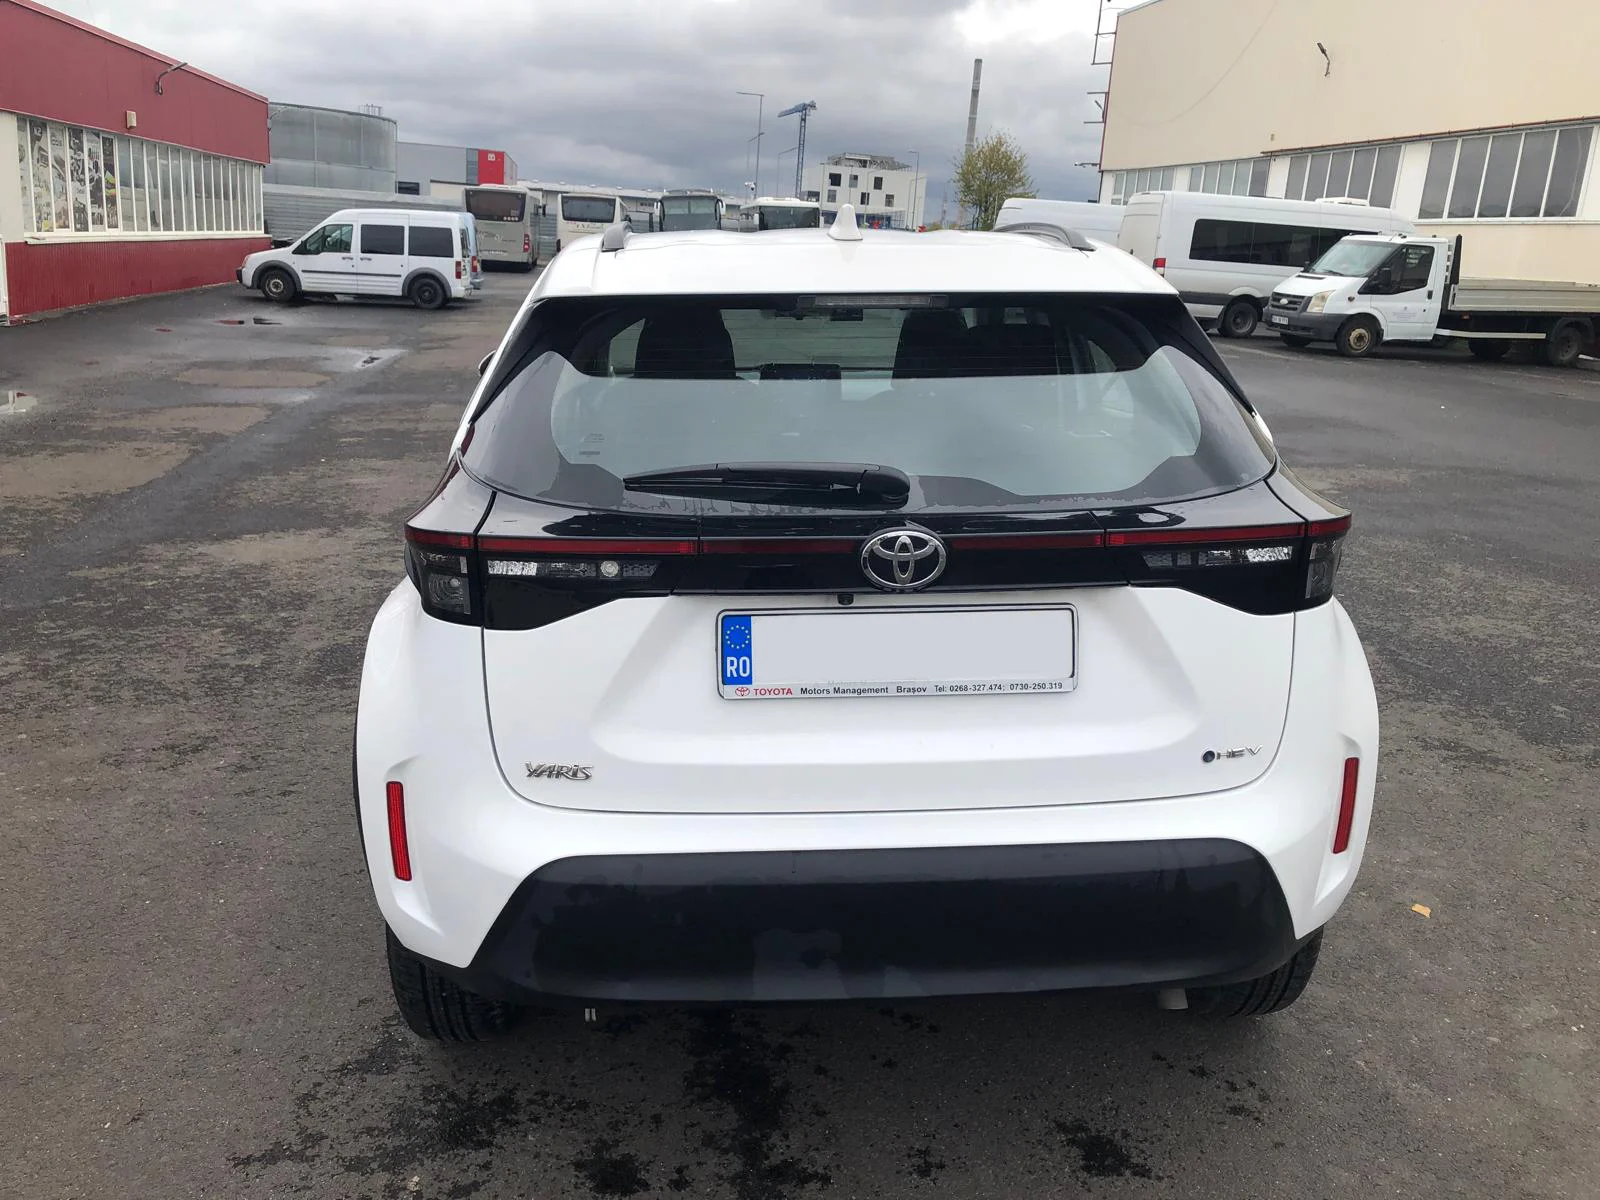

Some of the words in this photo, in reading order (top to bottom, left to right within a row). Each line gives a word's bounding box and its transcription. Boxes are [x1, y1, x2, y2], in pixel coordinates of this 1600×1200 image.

[726, 656, 750, 678] RO
[753, 688, 793, 697] TOYOTA
[800, 687, 831, 695] Motors
[833, 687, 889, 695] Management
[934, 684, 947, 692] Tel:
[1216, 745, 1263, 760] HEV
